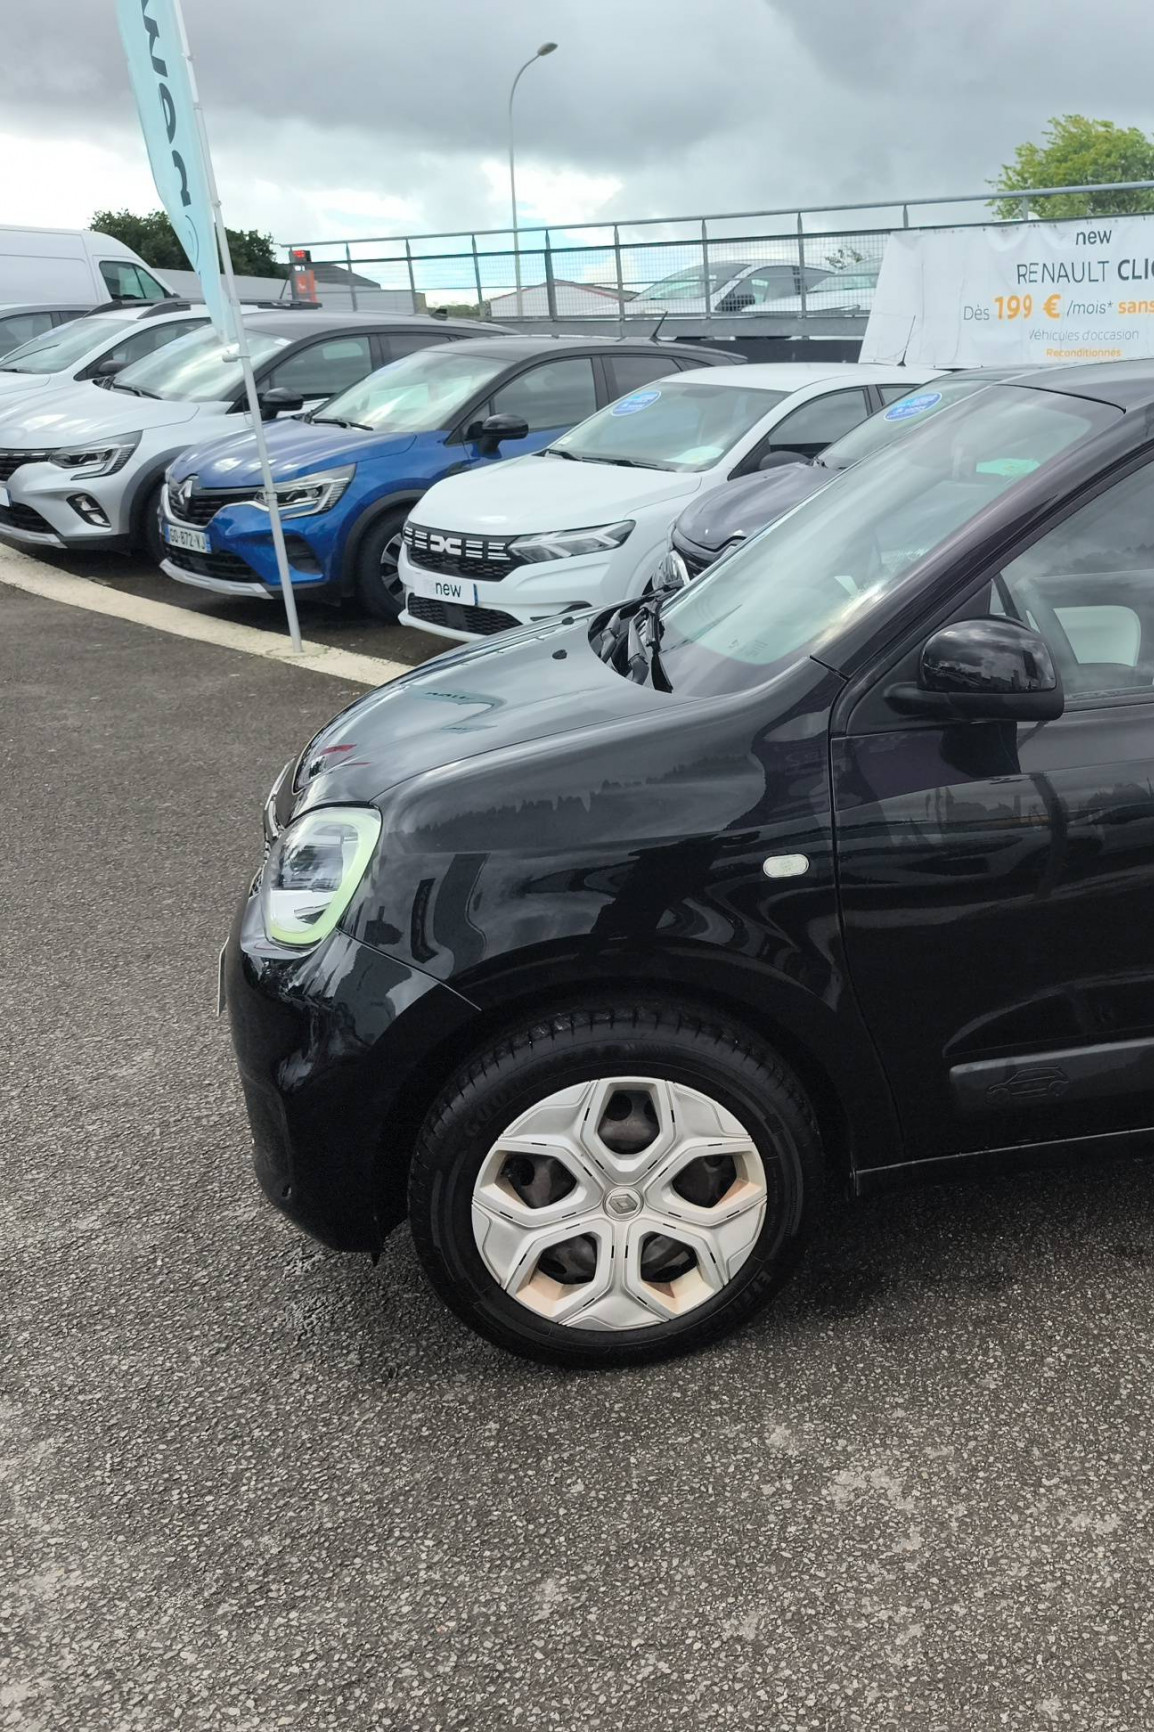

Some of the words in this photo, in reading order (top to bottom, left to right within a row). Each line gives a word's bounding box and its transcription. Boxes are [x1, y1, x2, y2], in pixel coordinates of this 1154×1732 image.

[1075, 230, 1112, 245] new
[1016, 260, 1110, 284] RENAULT
[963, 304, 990, 321] Dès
[994, 294, 1032, 320] 199
[1043, 294, 1062, 319] €
[435, 582, 461, 598] new
